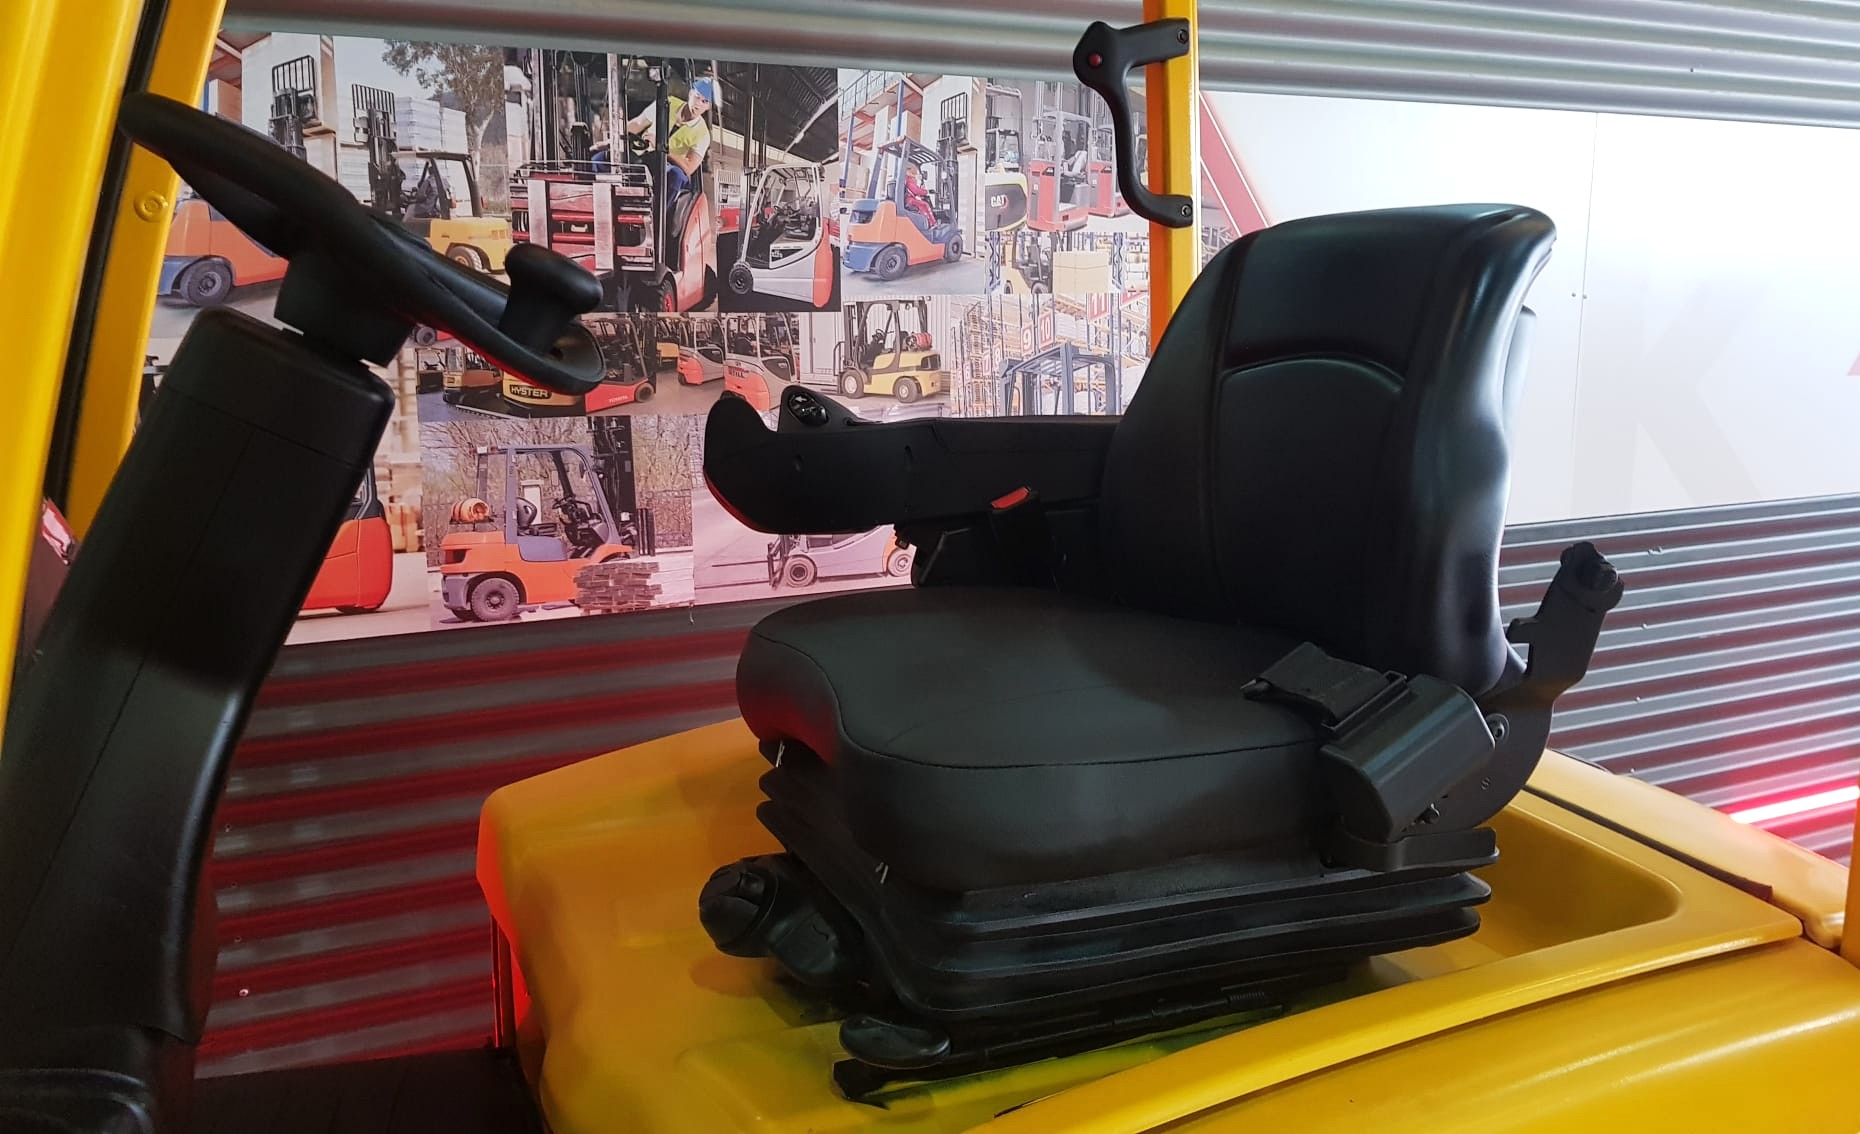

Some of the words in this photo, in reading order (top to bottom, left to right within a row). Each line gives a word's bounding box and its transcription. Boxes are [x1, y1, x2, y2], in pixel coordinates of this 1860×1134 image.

[990, 194, 1005, 208] CAT
[1040, 315, 1052, 341] 10
[1022, 330, 1032, 351] 9
[510, 385, 549, 399] HYSTER
